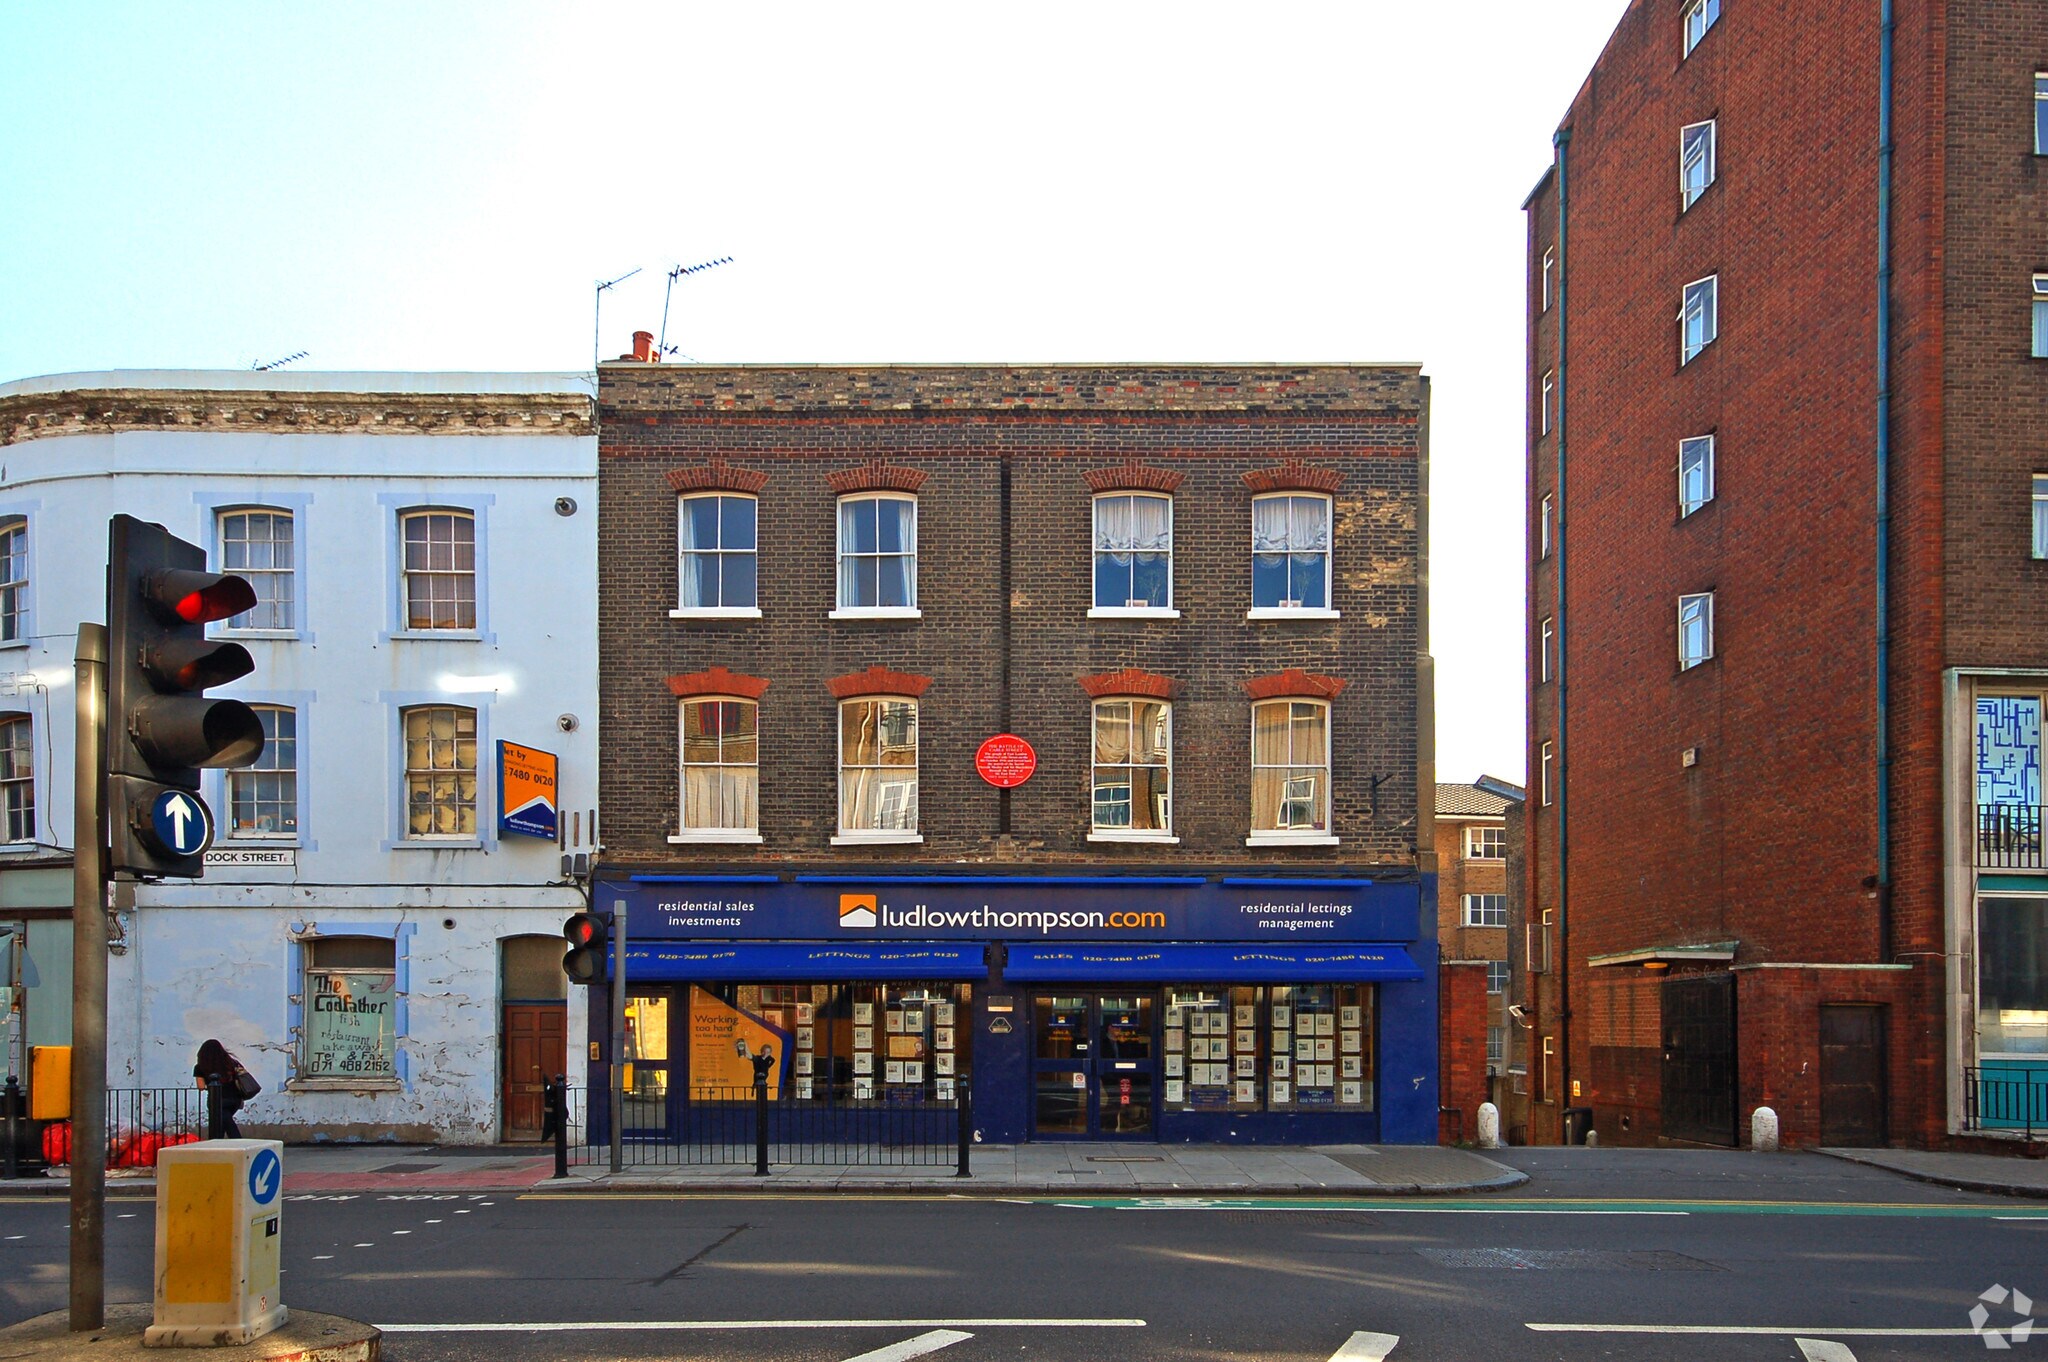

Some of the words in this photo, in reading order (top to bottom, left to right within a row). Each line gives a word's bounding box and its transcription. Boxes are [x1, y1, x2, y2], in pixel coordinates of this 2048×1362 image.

[508, 767, 530, 781] 7480
[533, 774, 553, 787] 0120
[205, 853, 238, 862] DOCK
[242, 853, 284, 862] STREET
[658, 900, 722, 911] residential
[725, 900, 755, 911] sales
[1240, 902, 1304, 913] residential
[1308, 902, 1353, 916] lettings
[668, 915, 741, 926] investments
[881, 903, 1167, 935] ludlowthompson.com
[1258, 919, 1335, 931] management
[807, 951, 871, 959] LETTINGS
[1233, 953, 1297, 962] LETTINGS
[314, 975, 342, 993] The
[695, 1014, 739, 1026] Working
[713, 1024, 733, 1032] hard
[347, 1051, 357, 1060] &
[361, 1051, 384, 1061] Fax
[311, 1061, 333, 1073] 071
[339, 1061, 362, 1072] 488
